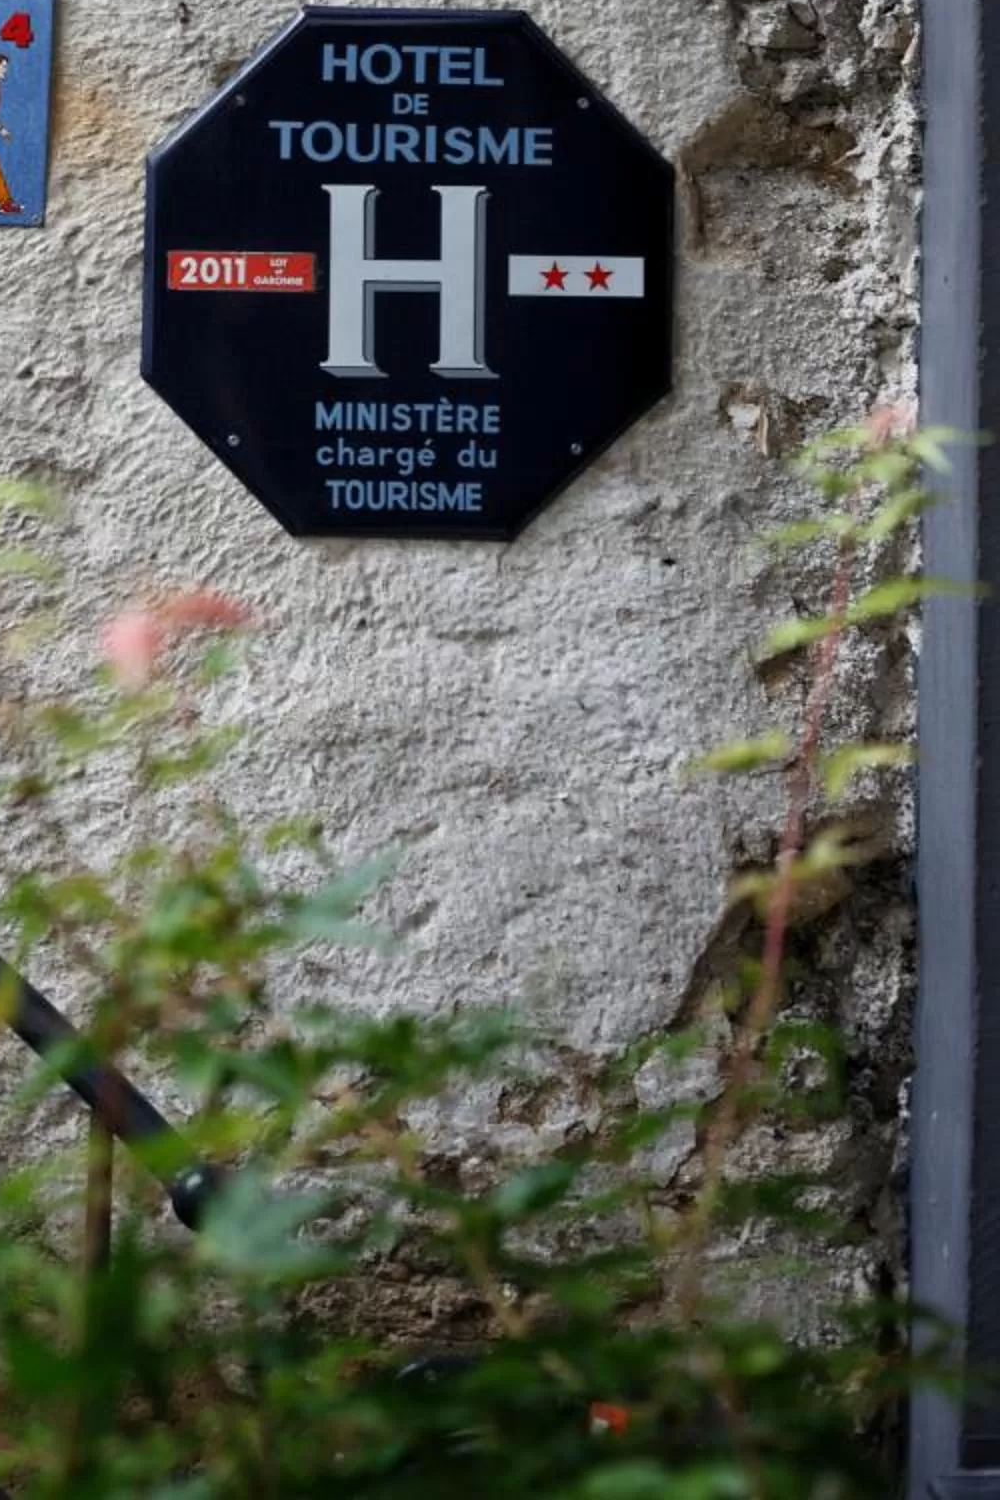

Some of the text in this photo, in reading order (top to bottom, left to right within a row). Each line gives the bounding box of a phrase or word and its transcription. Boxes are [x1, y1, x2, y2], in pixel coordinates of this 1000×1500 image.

[321, 43, 503, 86] HOTEL
[393, 93, 429, 115] DE
[269, 120, 553, 165] TOURISME
[180, 256, 247, 285] 2011
[320, 183, 500, 379] H
[315, 398, 500, 434] MINISTÈRE
[316, 438, 498, 475] chargé du
[326, 480, 483, 512] TOURISME
